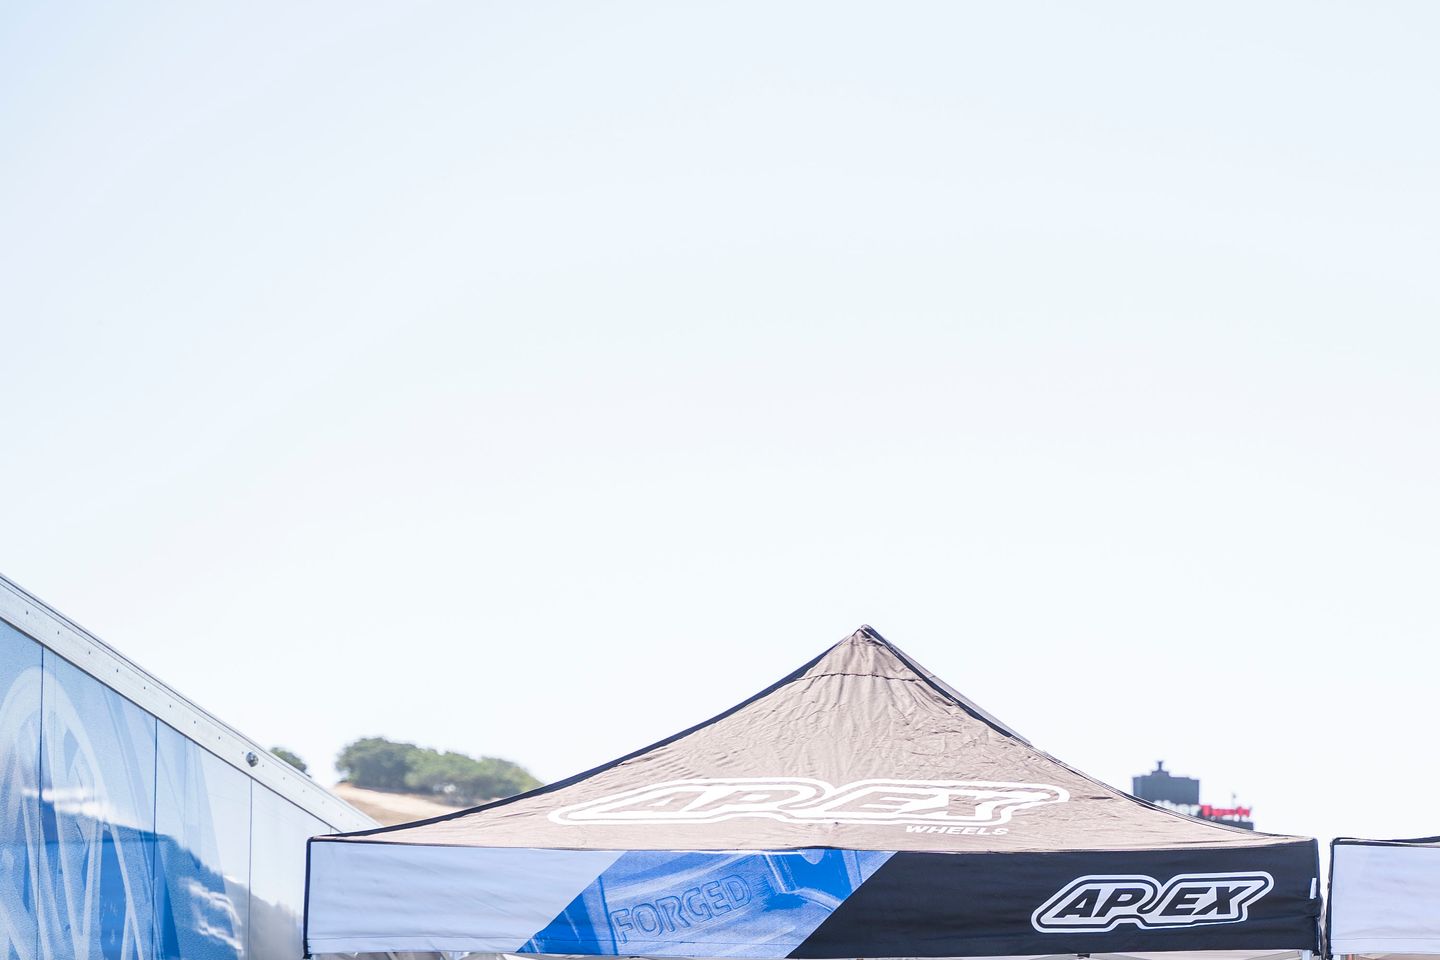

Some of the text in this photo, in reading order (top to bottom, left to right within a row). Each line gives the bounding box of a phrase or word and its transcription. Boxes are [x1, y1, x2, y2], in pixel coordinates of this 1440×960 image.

[558, 779, 1062, 824] APEX
[905, 825, 1010, 836] WHEELS
[611, 874, 752, 943] FORGED
[1039, 876, 1265, 927] APEX
